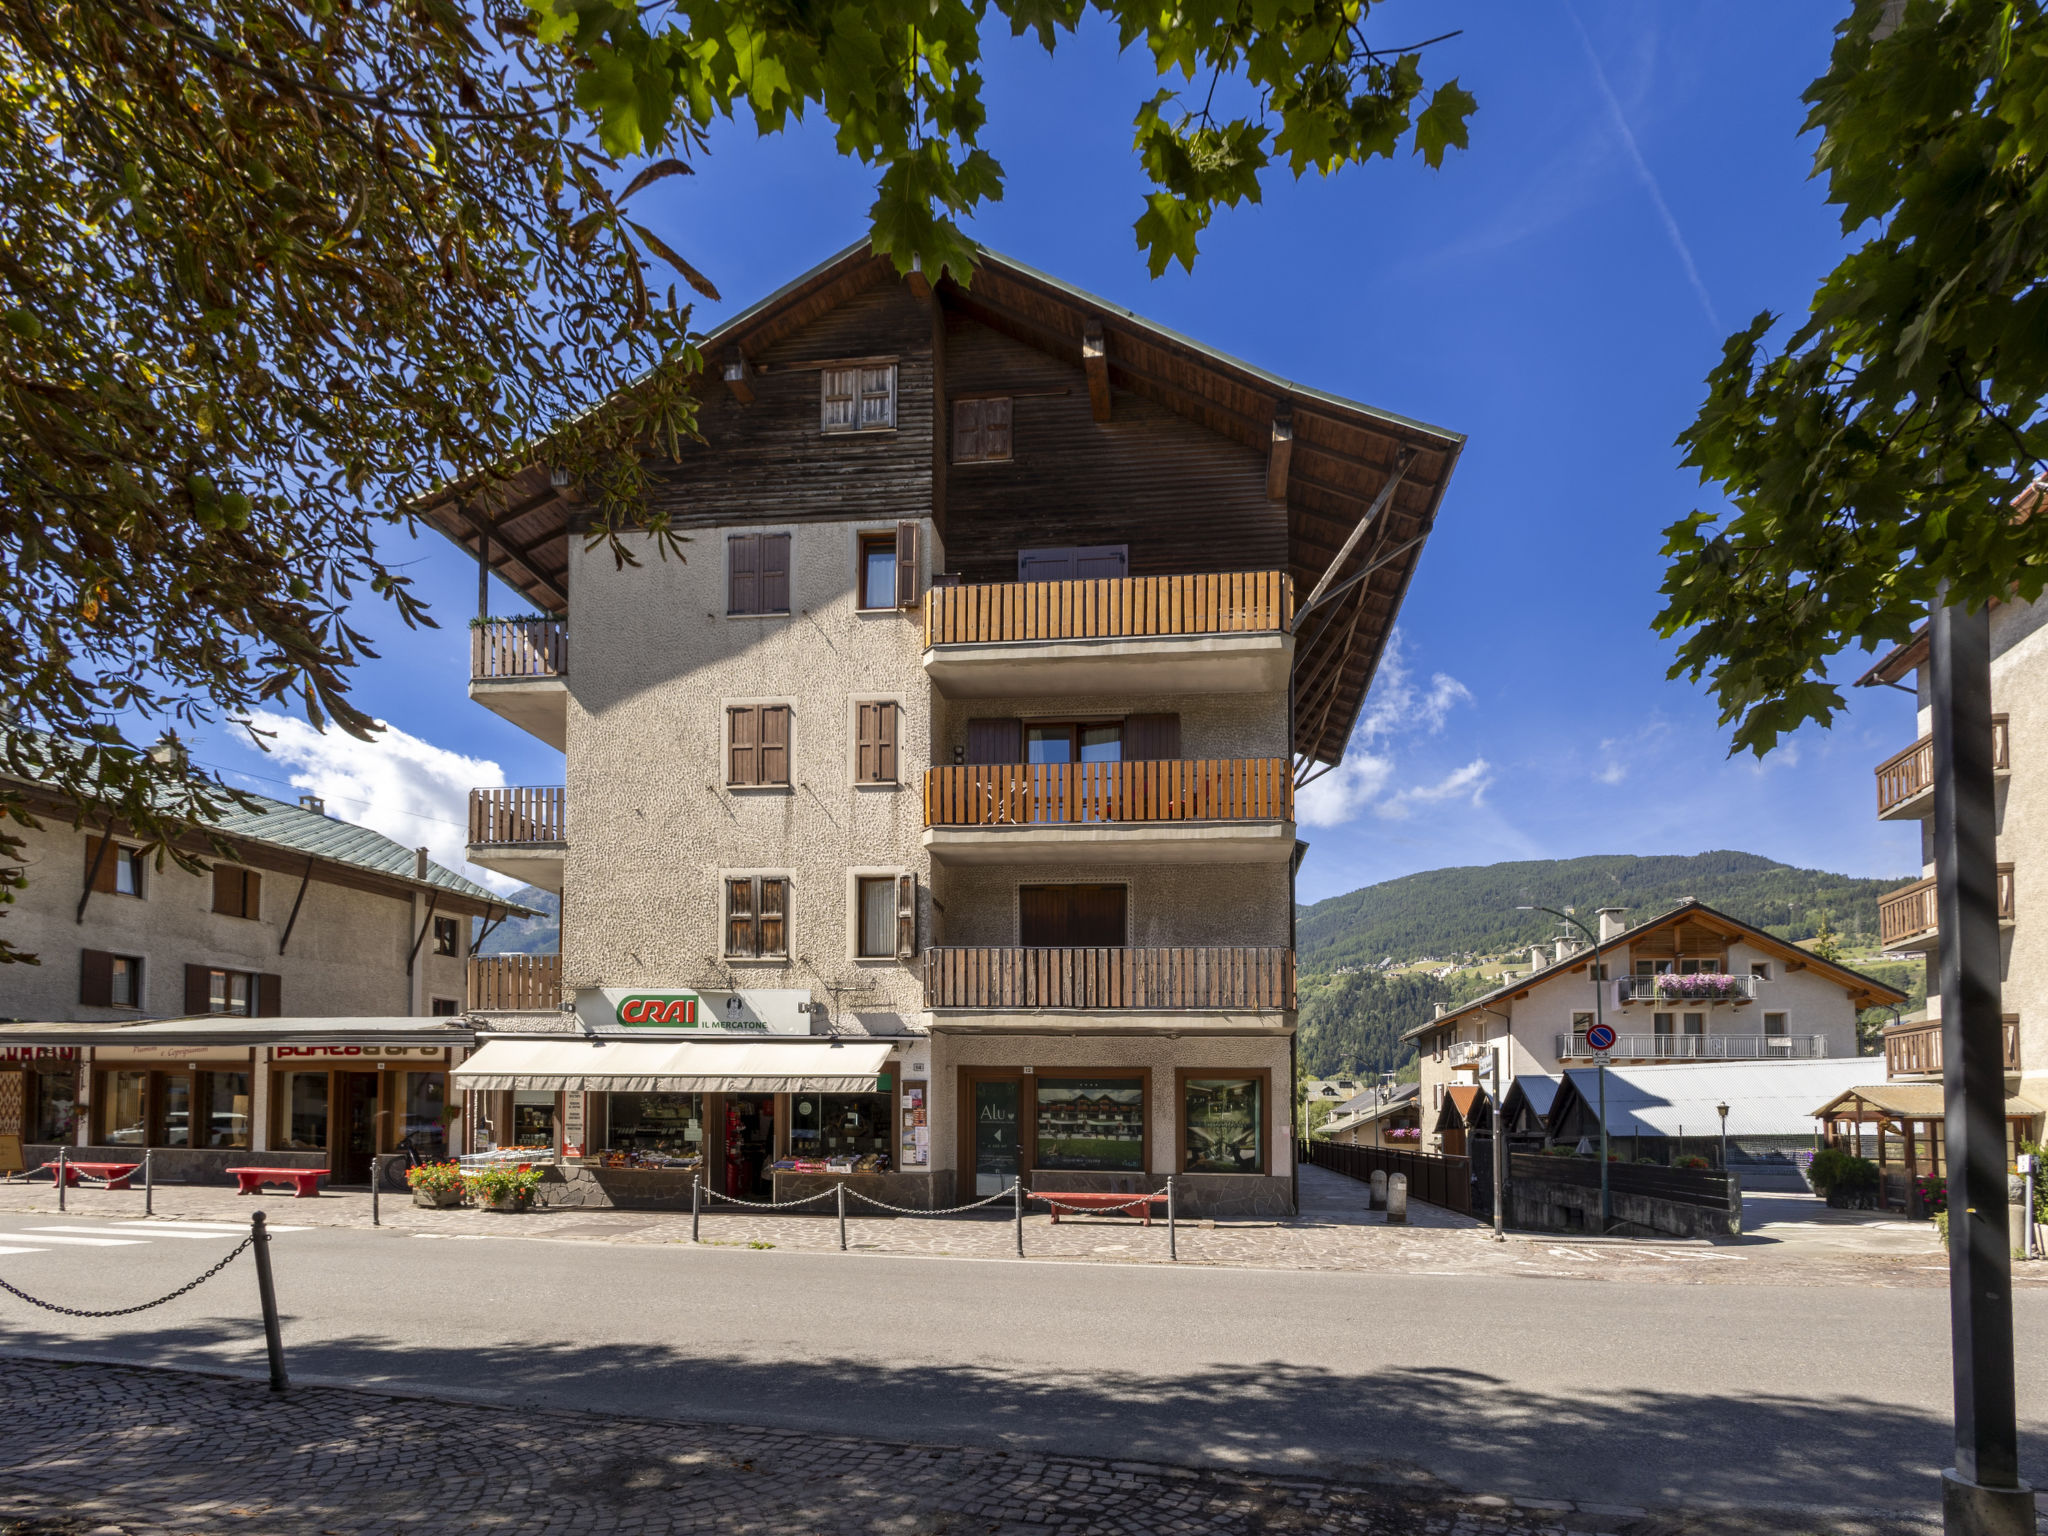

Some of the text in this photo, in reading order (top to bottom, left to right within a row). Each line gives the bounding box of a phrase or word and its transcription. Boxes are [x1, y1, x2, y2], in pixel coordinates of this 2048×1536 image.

[621, 999, 695, 1024] CRAI
[702, 1021, 768, 1029] IL MERCATONE
